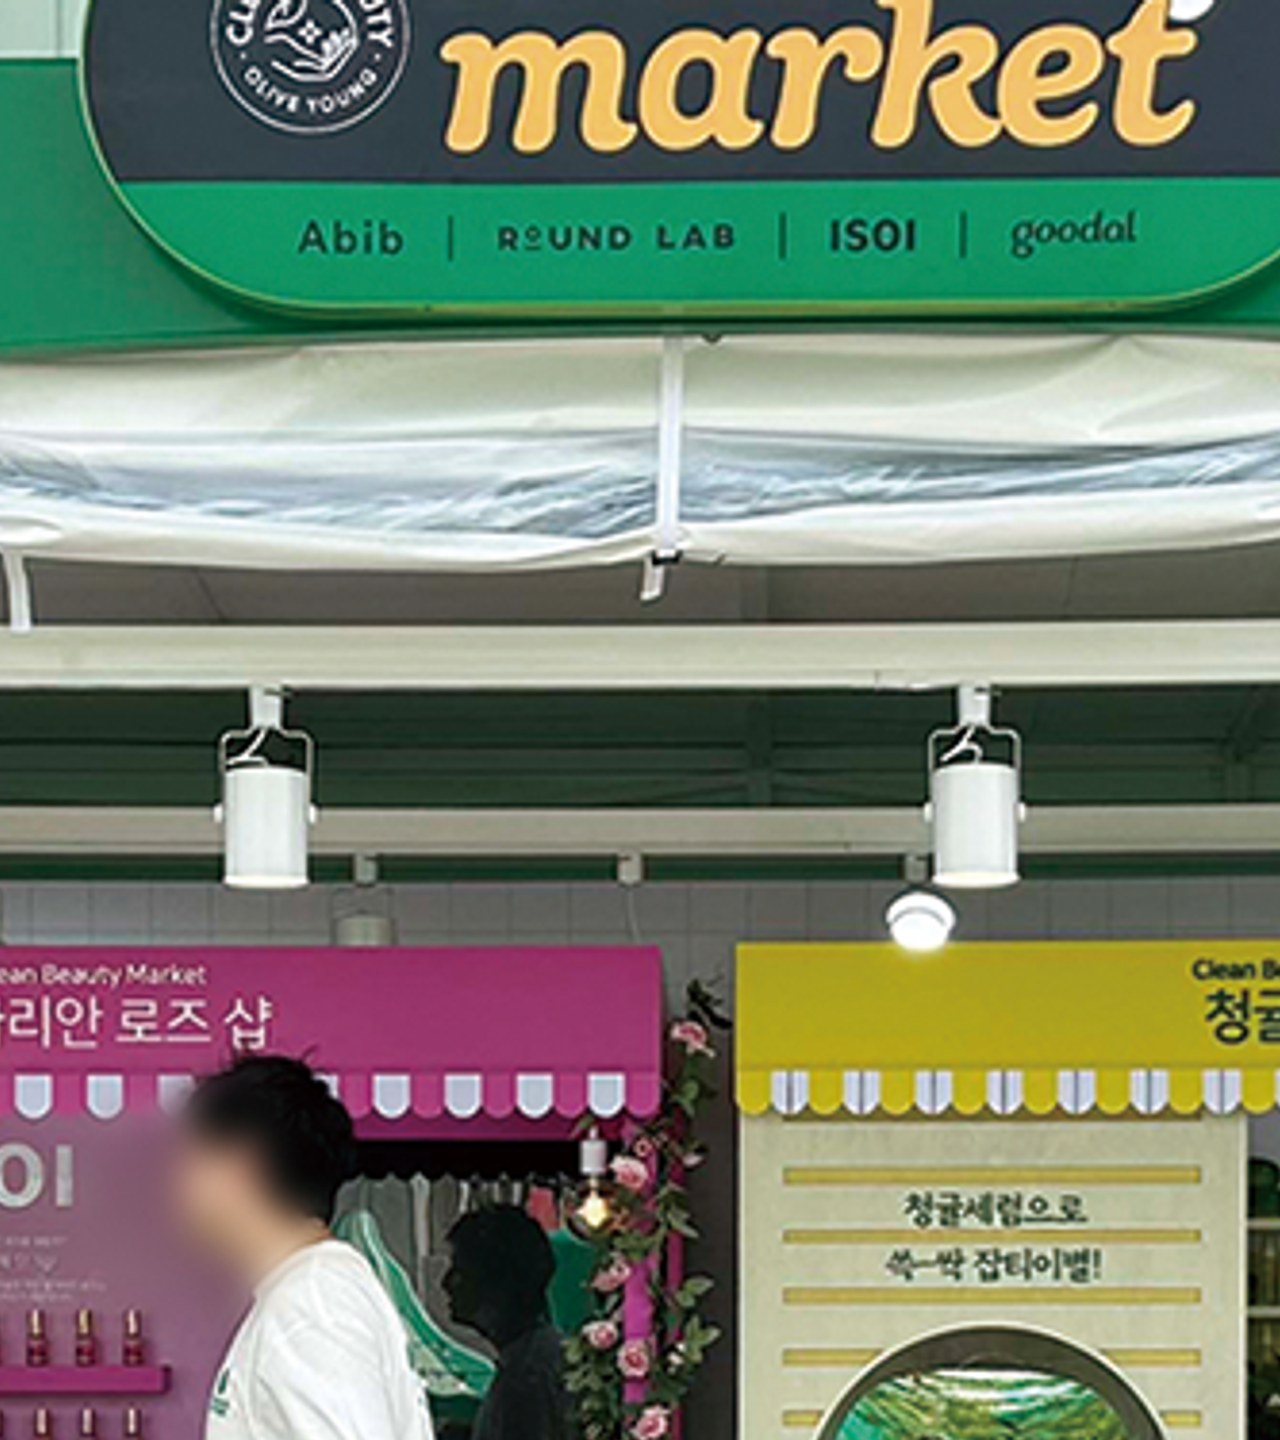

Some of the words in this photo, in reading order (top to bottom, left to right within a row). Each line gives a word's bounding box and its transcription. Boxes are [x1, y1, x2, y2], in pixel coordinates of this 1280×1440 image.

[244, 66, 300, 113] OLIVE
[306, 68, 378, 114] YOUNG
[440, 0, 1199, 152] market
[298, 219, 404, 256] Abib
[656, 225, 736, 250] LAB
[830, 218, 916, 252] ISOI
[1011, 210, 1137, 258] goodal
[41, 963, 121, 989] Beauty
[126, 964, 207, 985] Market
[1191, 958, 1256, 981] Clean
[115, 998, 211, 1043] 로즈
[224, 996, 273, 1049] 샵
